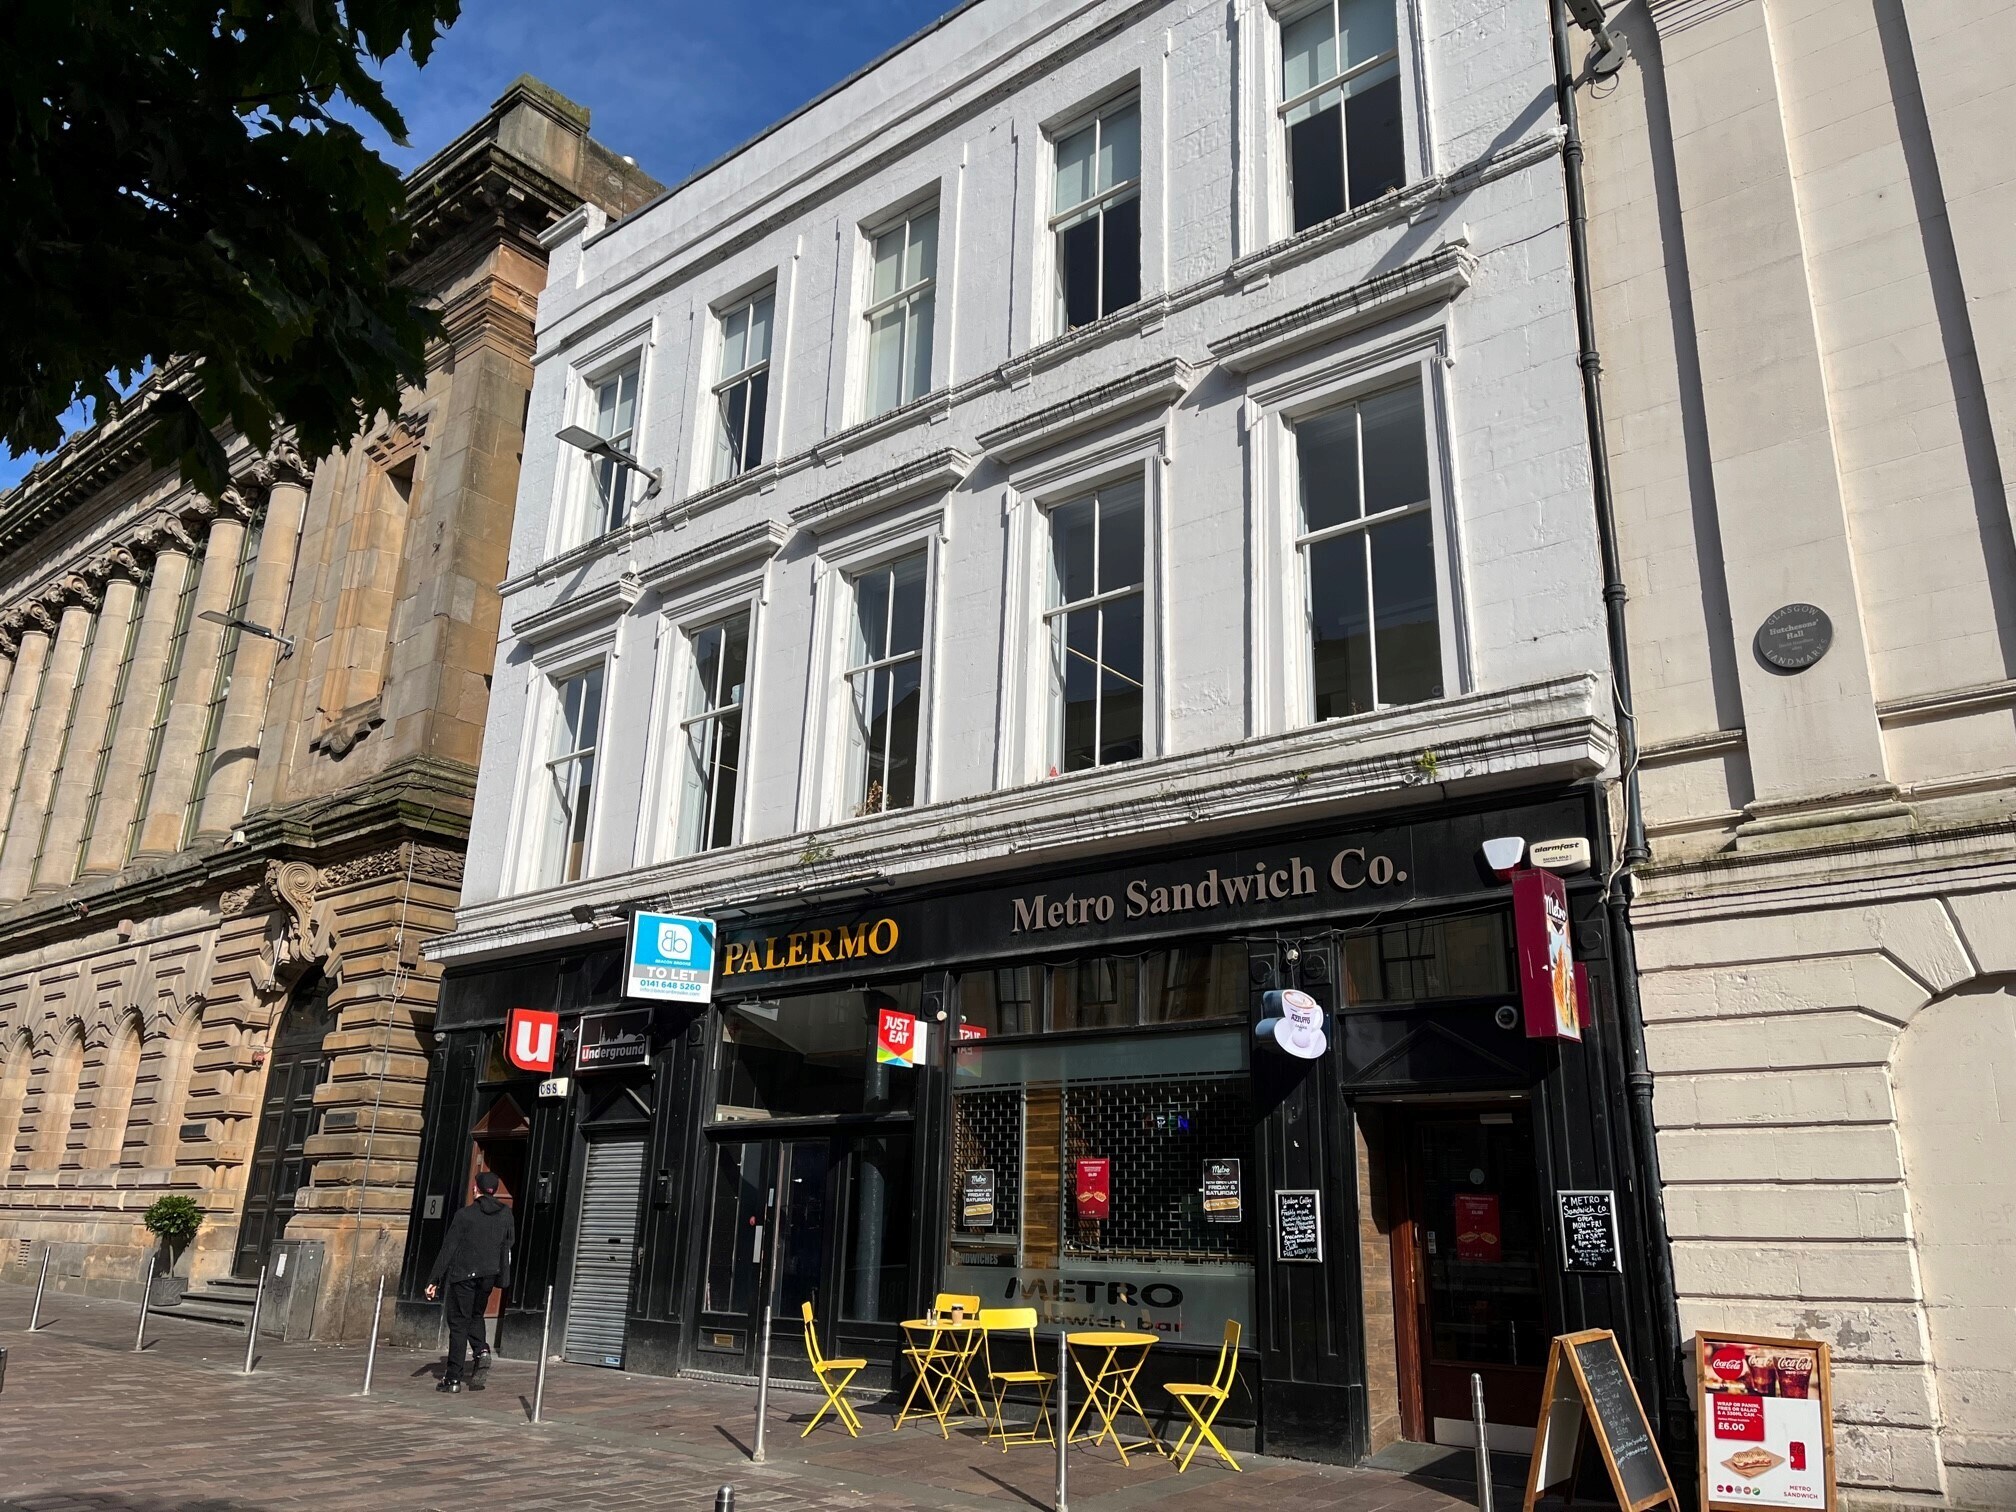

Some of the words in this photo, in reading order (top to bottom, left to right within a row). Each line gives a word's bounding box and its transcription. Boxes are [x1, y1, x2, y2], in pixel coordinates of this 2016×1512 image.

[1767, 605, 1818, 625] GLASGOW
[1786, 630, 1804, 640] Hall
[1766, 638, 1828, 665] LANDMARKS
[1534, 842, 1580, 853] alarmfast
[1010, 893, 1115, 934] Metro
[1126, 857, 1318, 919] Sandwich
[1331, 847, 1408, 890] Co.
[722, 918, 899, 976] PALERMO
[647, 966, 668, 979] TO
[671, 968, 698, 981] LET
[640, 979, 659, 988] 0141
[661, 981, 678, 989] 648
[680, 982, 701, 991] 5260
[884, 1015, 910, 1031] JUST
[888, 1030, 910, 1044] EAT
[582, 1043, 645, 1062] underground
[430, 1199, 437, 1216] 8
[1570, 1196, 1600, 1206] METRO
[1563, 1205, 1596, 1215] Sandwich
[1004, 1276, 1184, 1308] METRO
[1137, 1316, 1184, 1332] bar
[1718, 1421, 1746, 1432] £6.00
[1783, 1491, 1819, 1500] SANDWICH
[1789, 1485, 1812, 1493] METRO
